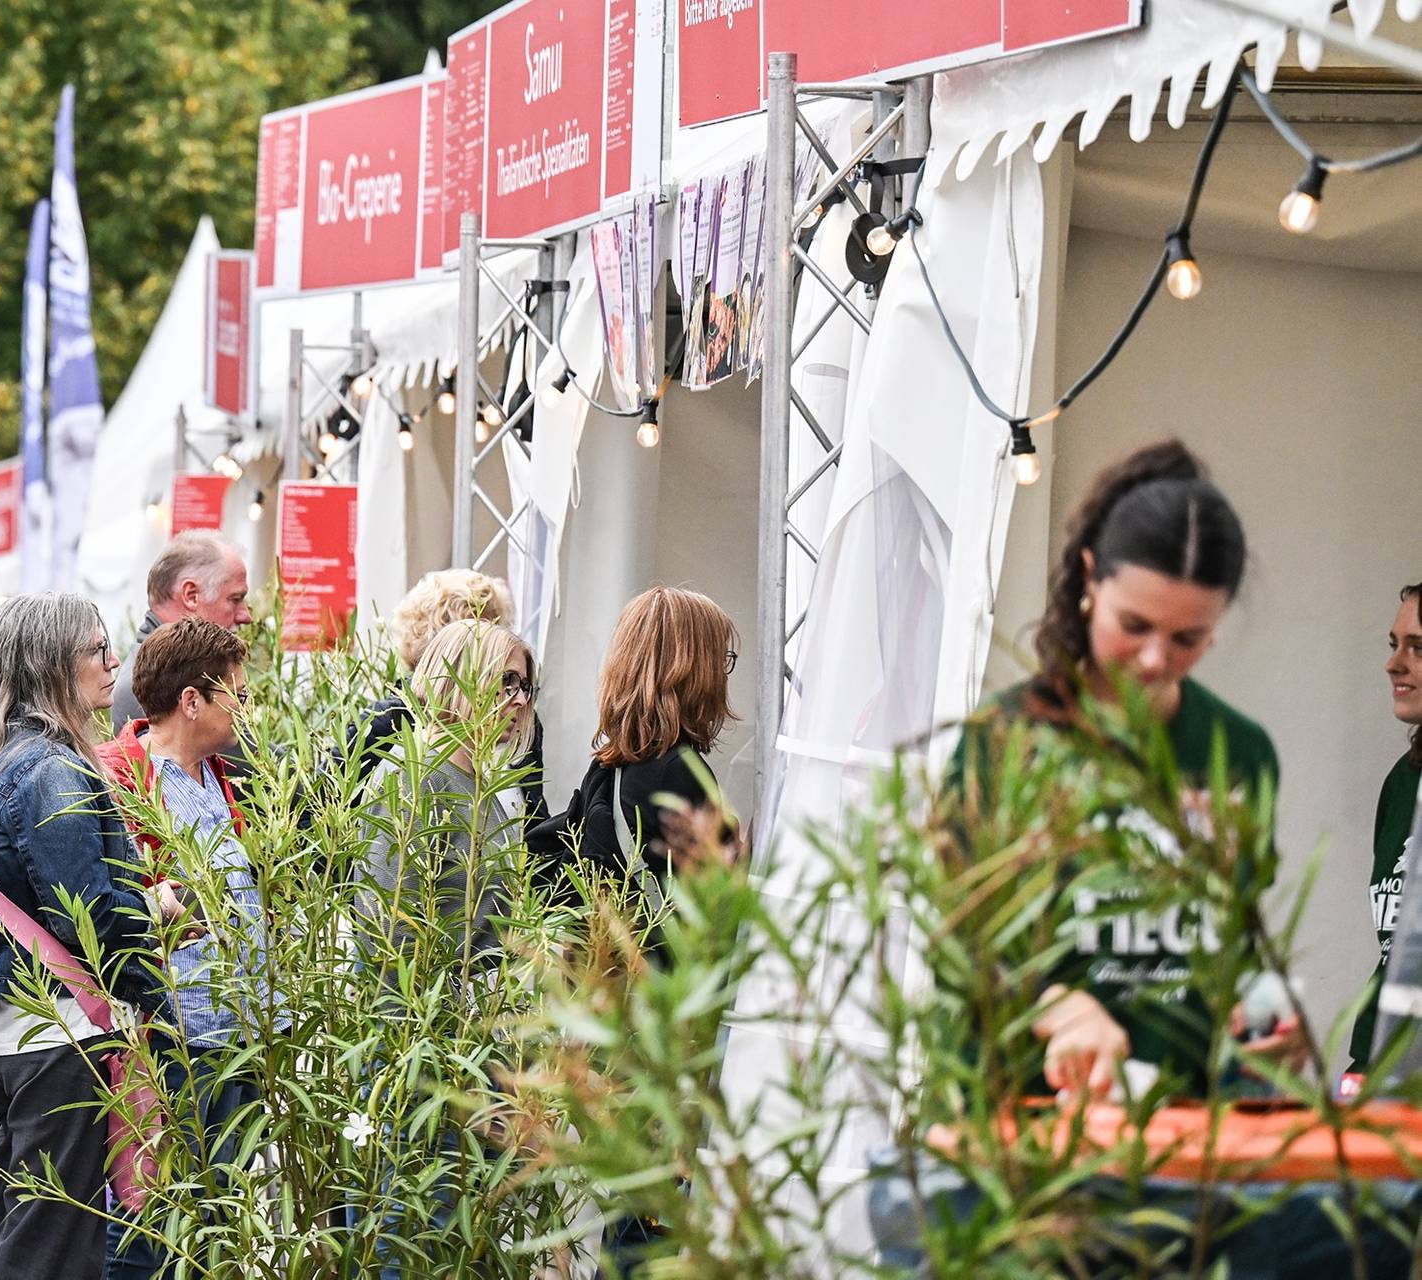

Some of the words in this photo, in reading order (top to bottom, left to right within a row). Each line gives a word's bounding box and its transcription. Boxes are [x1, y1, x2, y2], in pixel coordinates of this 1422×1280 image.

[524, 9, 563, 105] Samui
[317, 147, 403, 245] Bio-Crêperie
[496, 133, 542, 197] Thailändische
[541, 117, 590, 199] Spezialitäten
